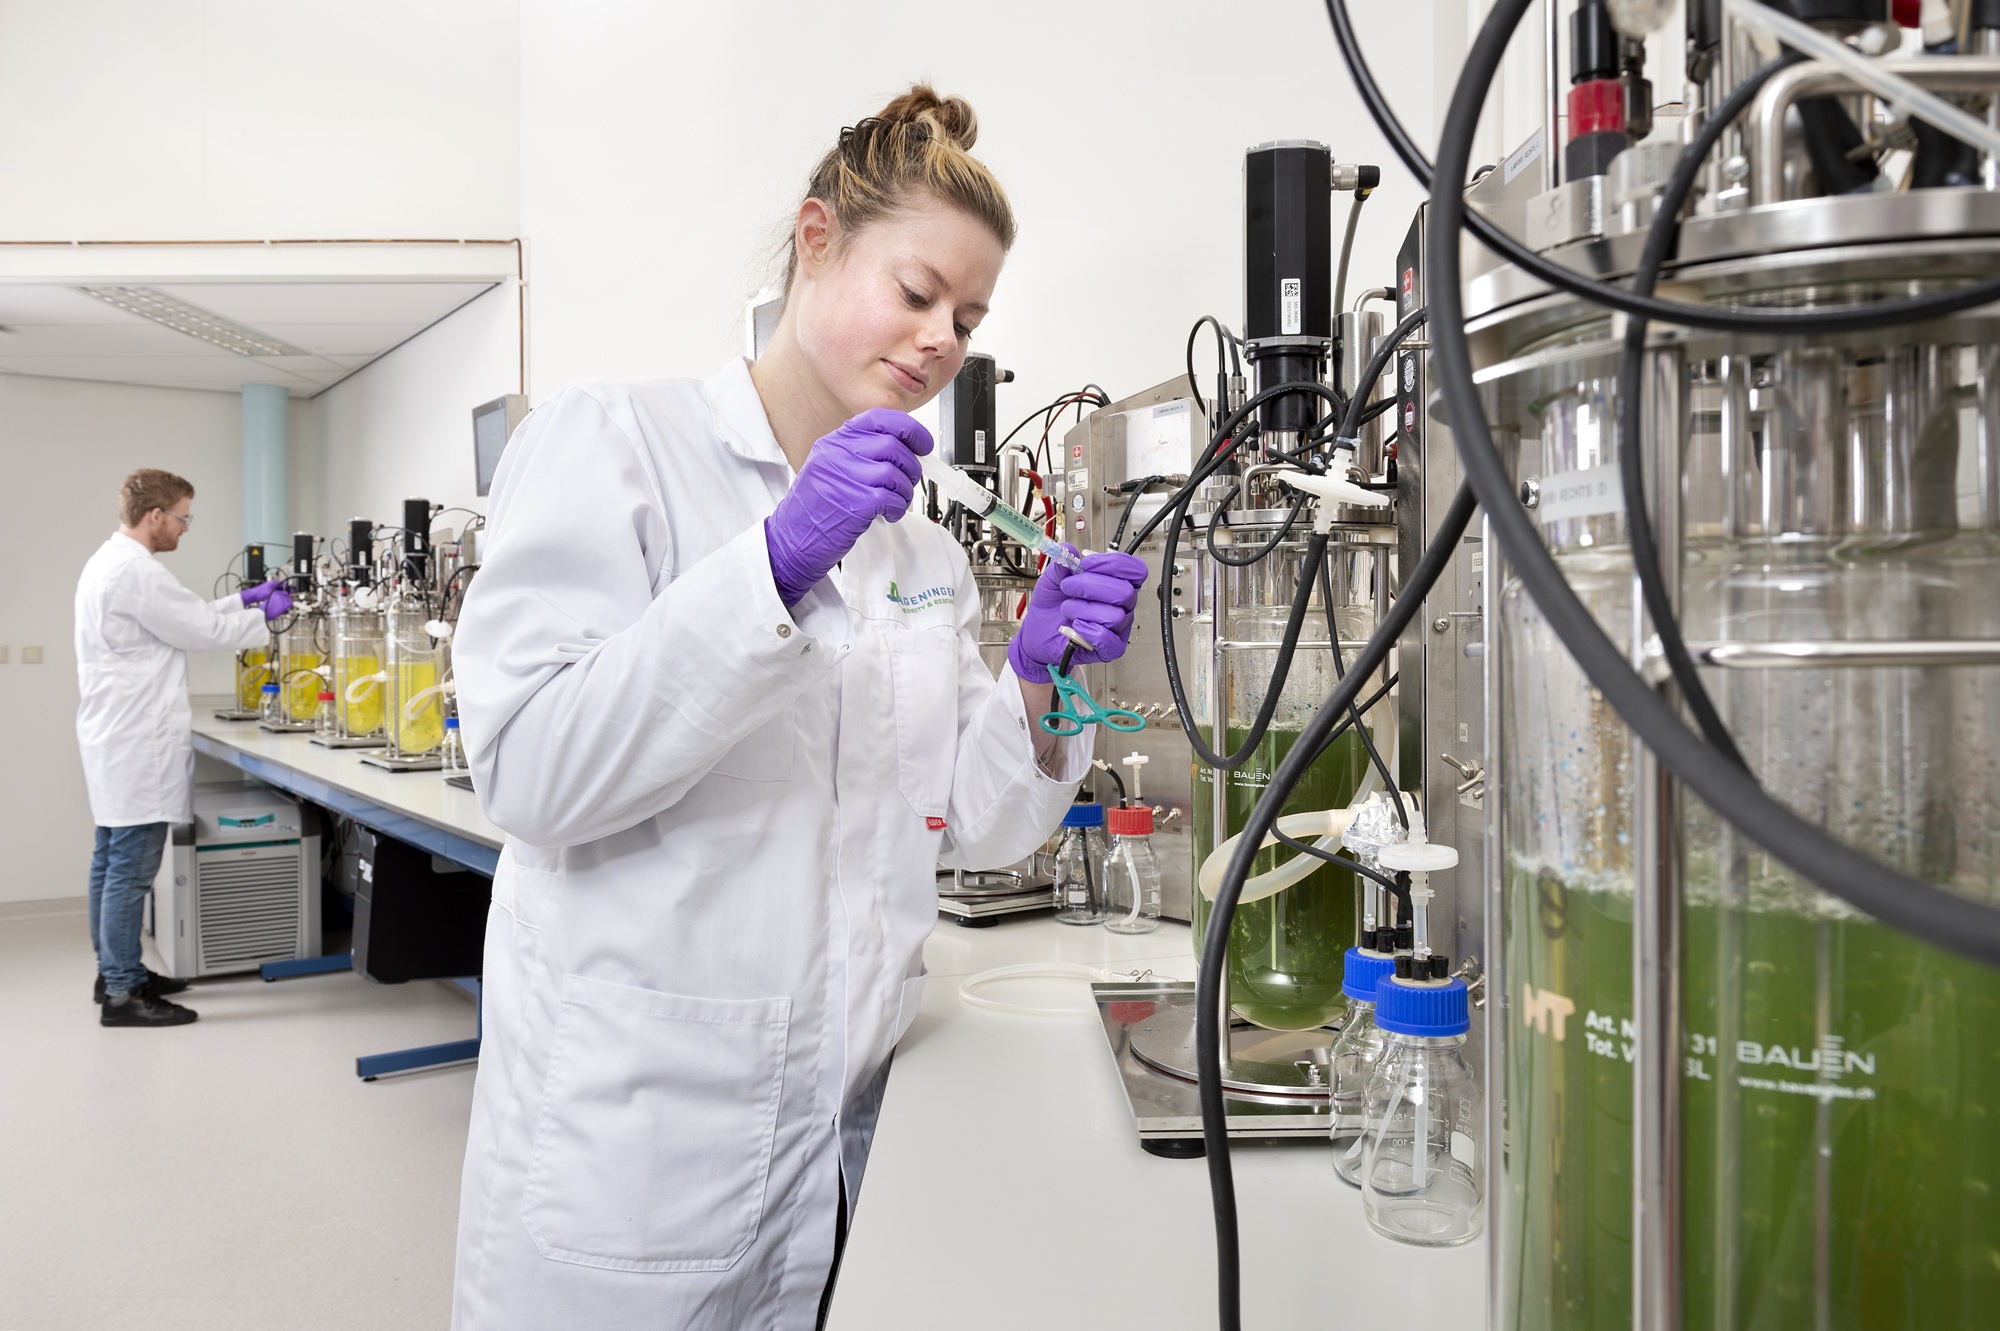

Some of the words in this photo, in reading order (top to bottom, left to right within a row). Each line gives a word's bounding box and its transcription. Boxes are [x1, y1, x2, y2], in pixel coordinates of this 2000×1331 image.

[1233, 767, 1271, 782] BAUEN
[1584, 1010, 1617, 1035] Art.
[1736, 1034, 1876, 1080] BAUEN
[1585, 1032, 1617, 1059] Tot.
